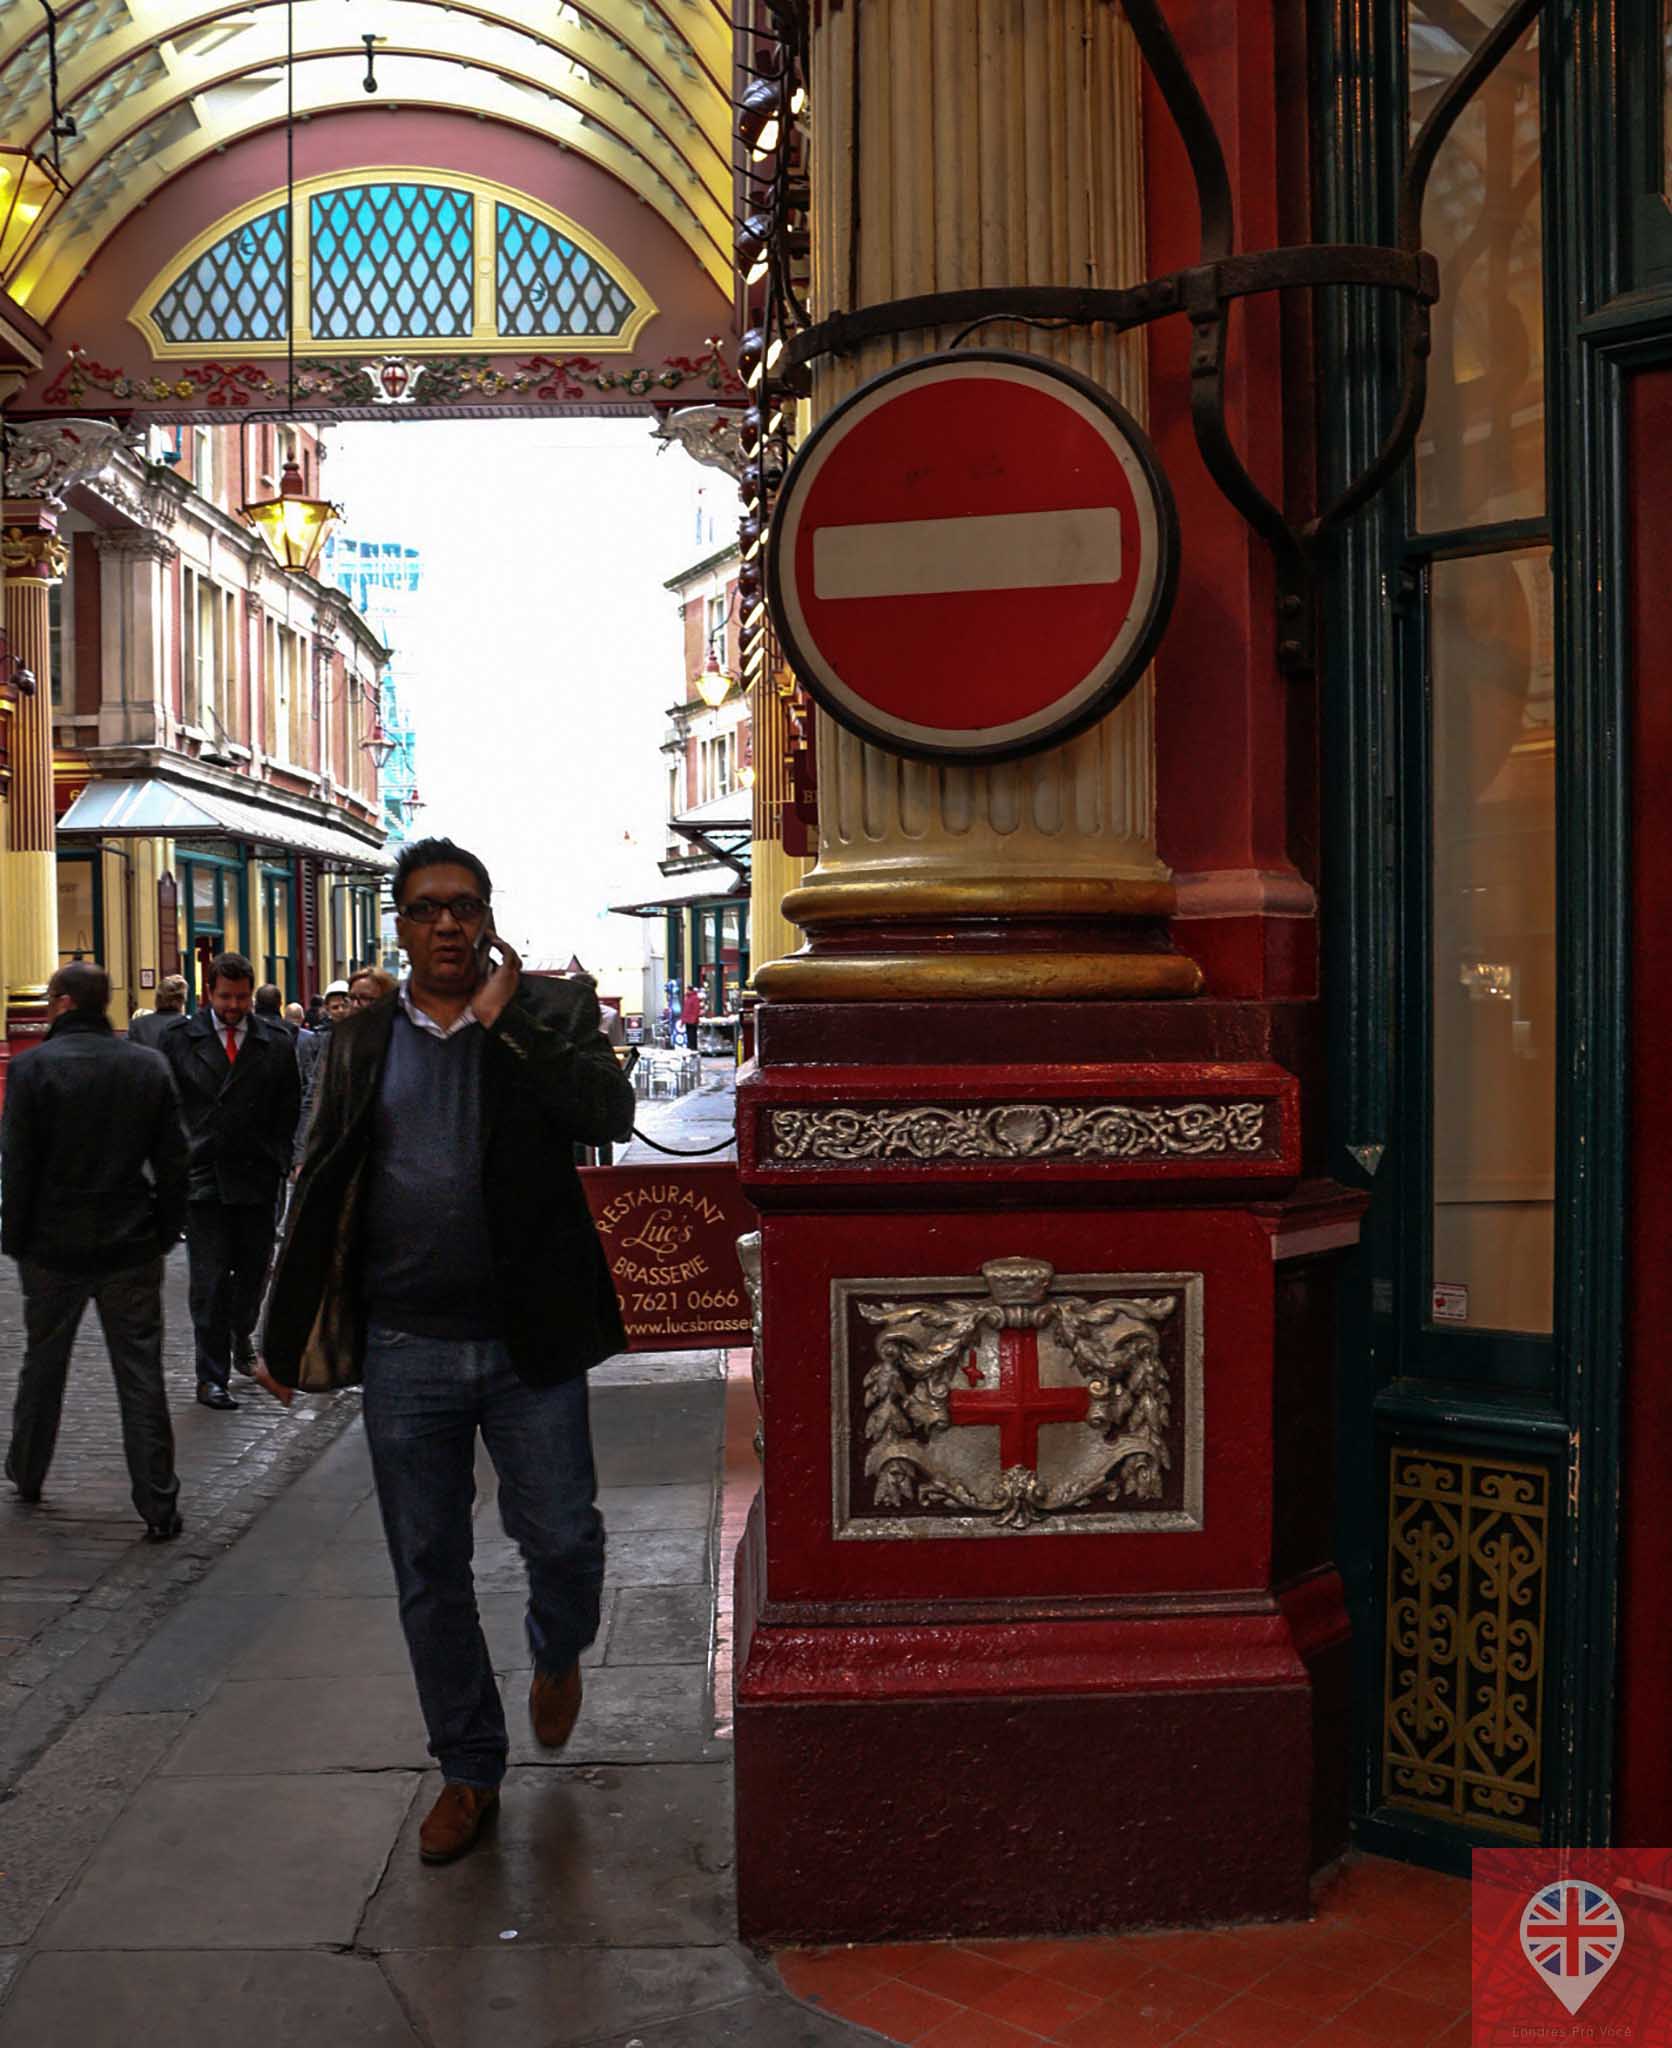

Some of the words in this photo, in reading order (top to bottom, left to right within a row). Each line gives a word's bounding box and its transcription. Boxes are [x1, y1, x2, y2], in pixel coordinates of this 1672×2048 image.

[595, 1185, 726, 1234] RESTAURANT
[621, 1208, 694, 1262] Luc's
[612, 1255, 710, 1286] BRASSERIE
[631, 1291, 678, 1312] 7621
[687, 1289, 739, 1310] 0666
